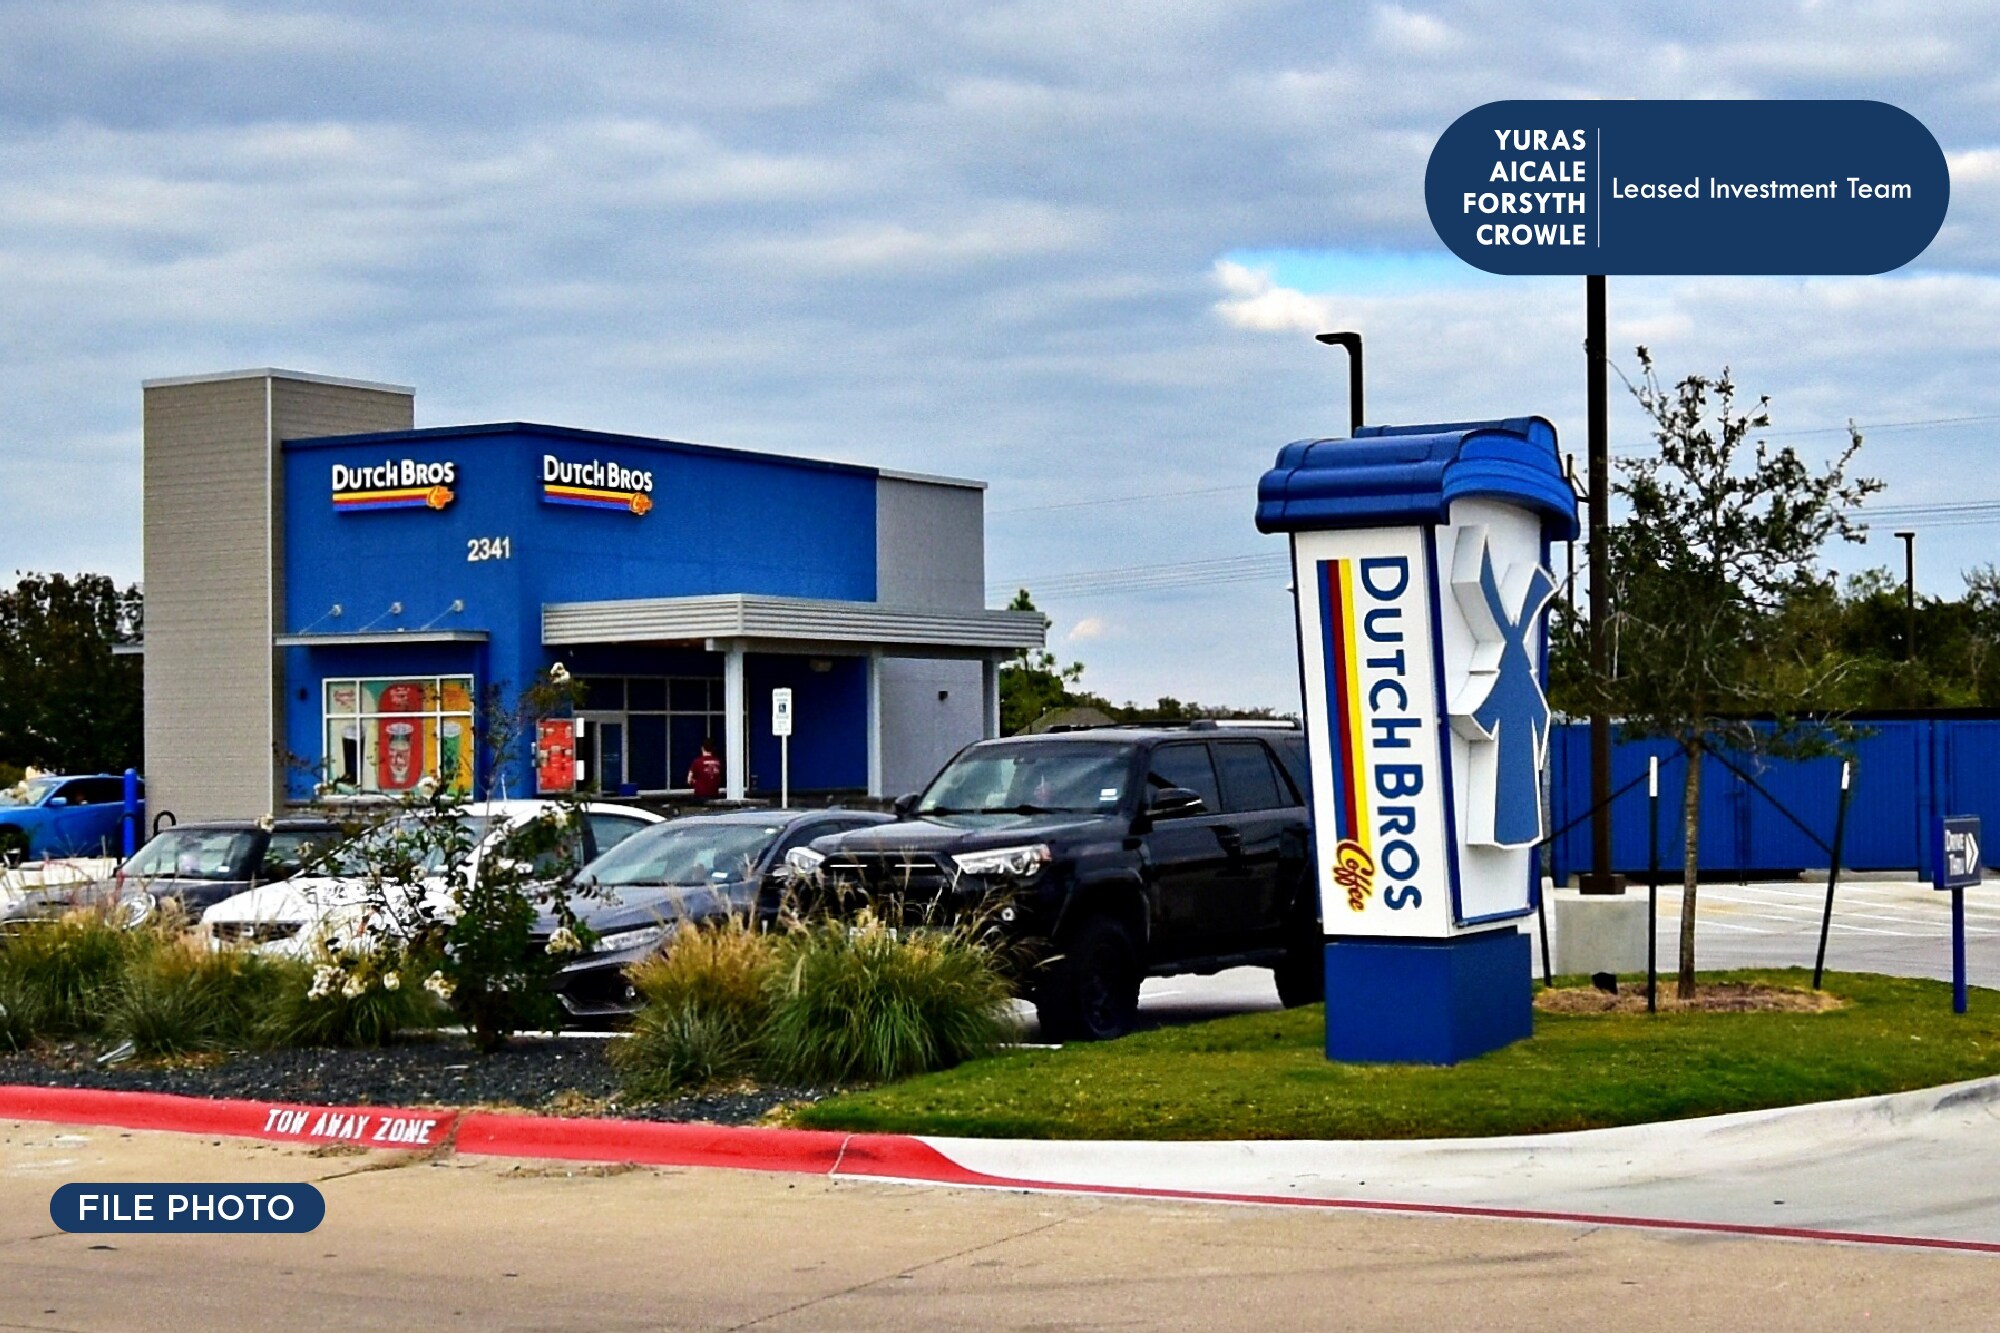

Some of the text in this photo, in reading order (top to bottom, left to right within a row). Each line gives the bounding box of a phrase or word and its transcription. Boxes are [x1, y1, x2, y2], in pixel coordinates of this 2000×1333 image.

[401, 459, 455, 486] BROS
[607, 462, 653, 492] BROS
[467, 536, 510, 562] 2341
[1360, 555, 1424, 911] DUTCH BROS
[1332, 839, 1375, 911] Coffee
[263, 1108, 437, 1145] TOW AWAY ZONE
